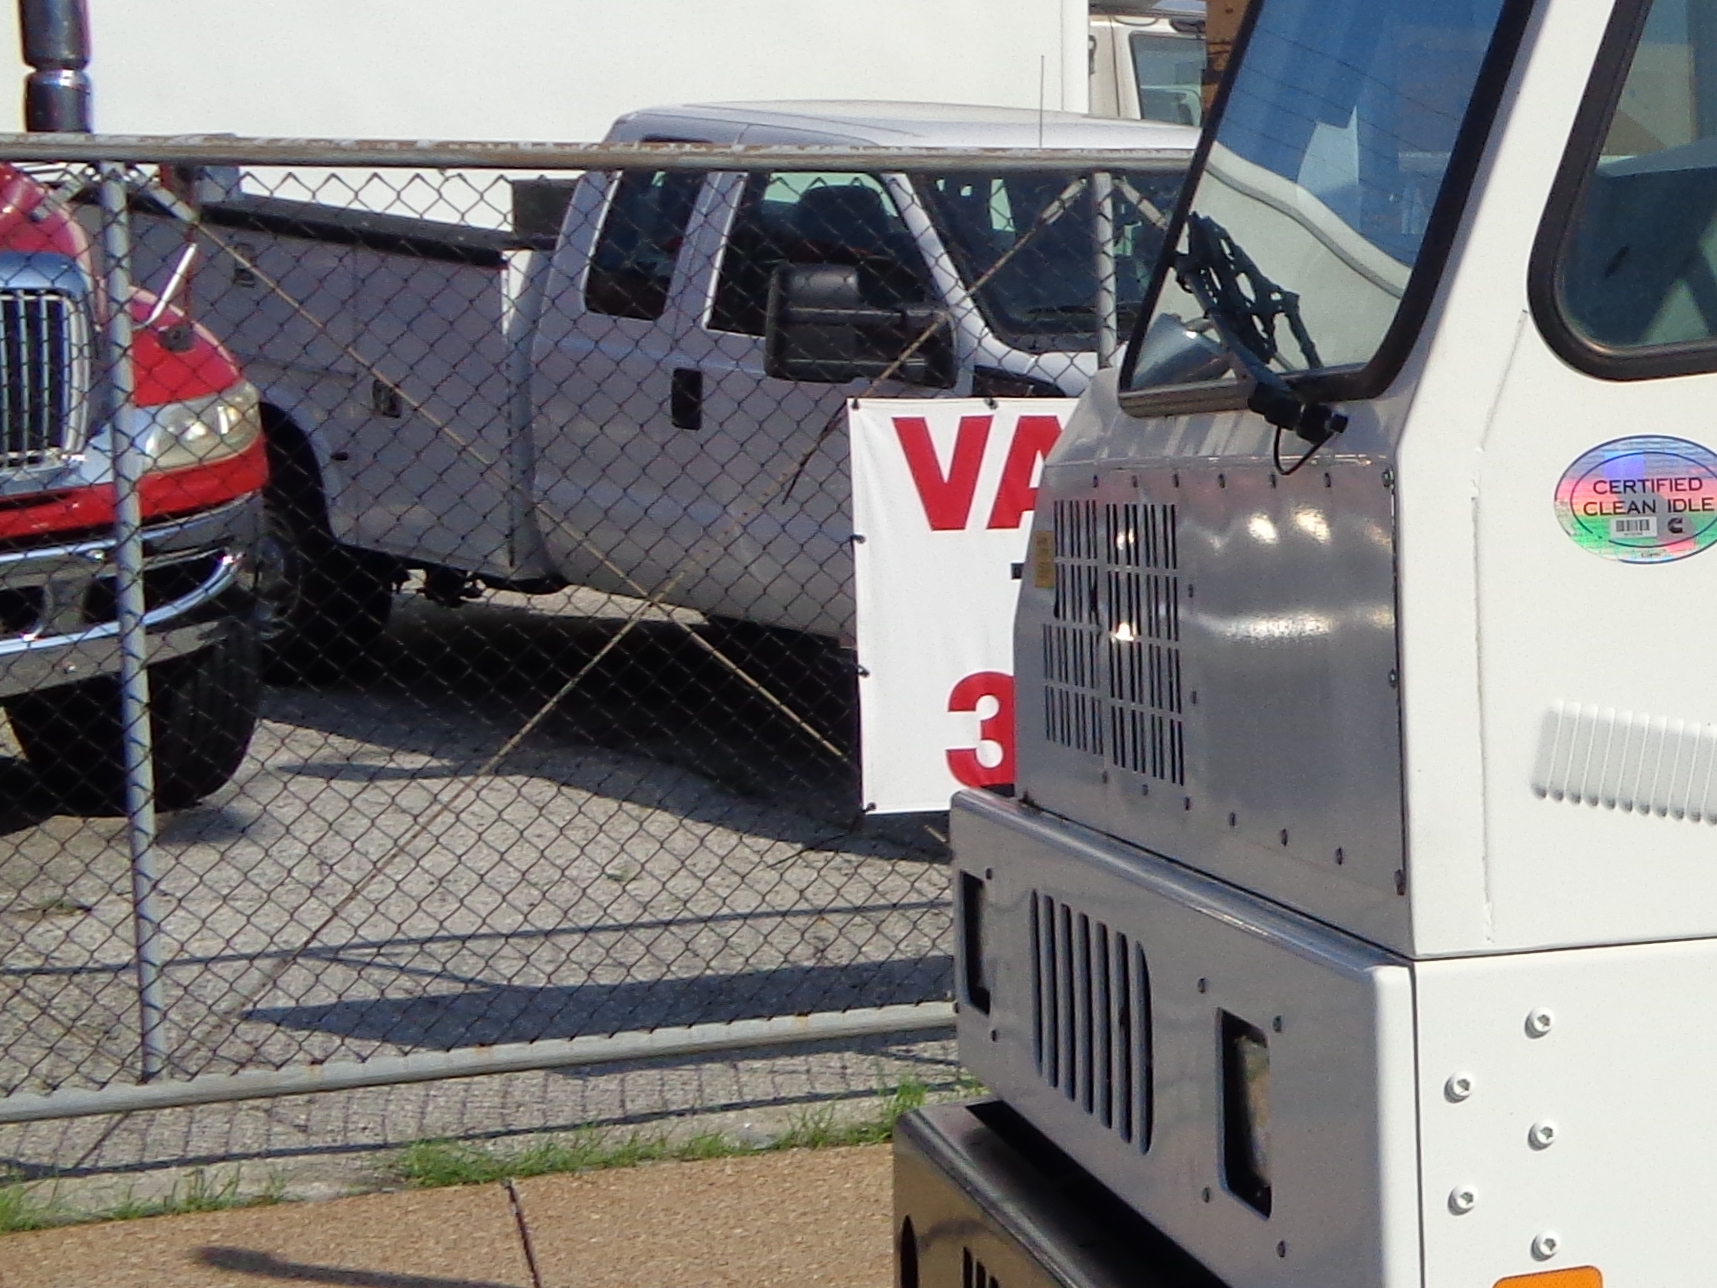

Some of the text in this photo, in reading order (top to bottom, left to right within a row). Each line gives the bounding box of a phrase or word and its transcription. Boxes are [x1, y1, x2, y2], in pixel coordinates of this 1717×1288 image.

[1592, 476, 1703, 495] CERTIFIED
[1582, 497, 1715, 517] CLEAN IDLE
